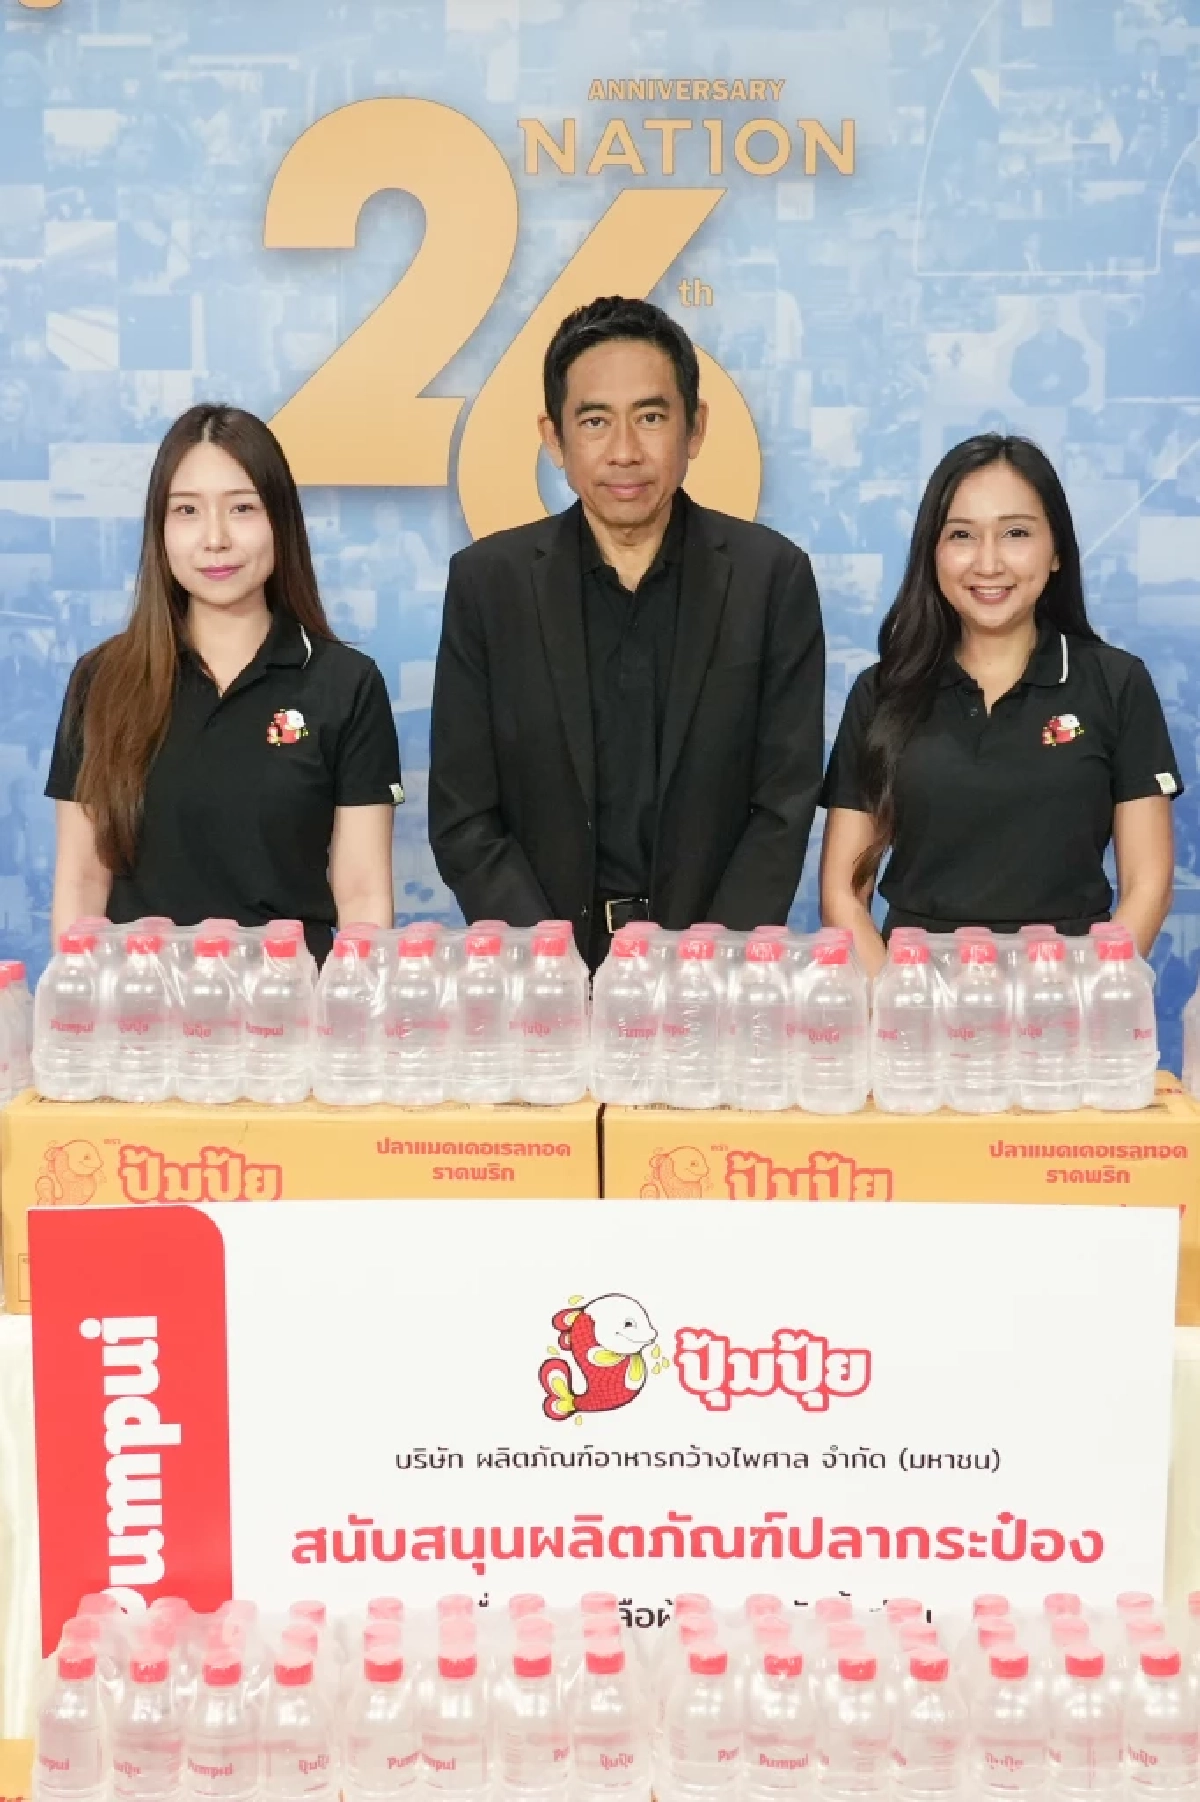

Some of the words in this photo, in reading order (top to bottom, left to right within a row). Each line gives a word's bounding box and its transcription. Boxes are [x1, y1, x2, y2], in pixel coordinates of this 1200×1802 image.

[588, 79, 786, 101] ANNIVERSARY
[517, 118, 856, 176] NATION
[678, 279, 714, 307] th
[432, 1163, 515, 1181] ราดพริก
[1046, 1165, 1131, 1184] ราดพริก
[674, 1327, 871, 1413] ปุ้มปุ้ย
[395, 1447, 464, 1469] บริษัท
[476, 1444, 809, 1469] ผลิตภัณฑ์อาหารกว้างไพศาล
[821, 1445, 887, 1469] จำกัด
[898, 1446, 1001, 1473] (มหาชน)
[291, 1510, 1104, 1576] สนับสนุนผลิตภัณฑ์ปลากระป๋อง
